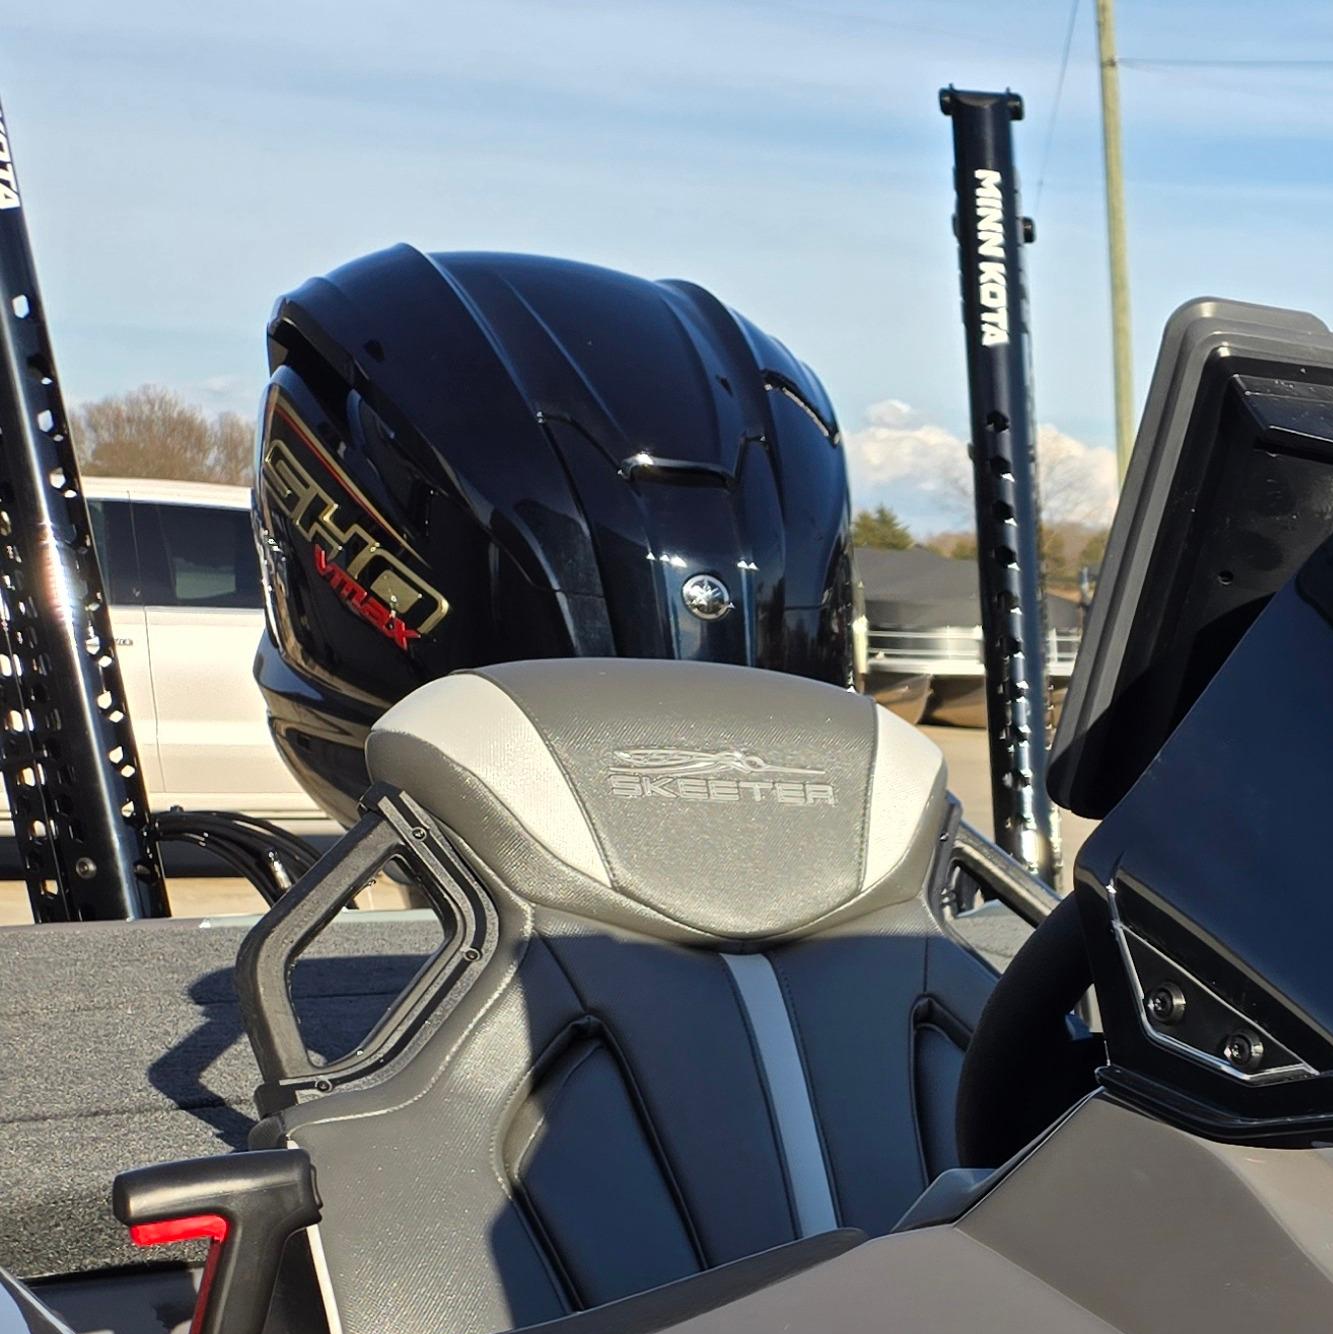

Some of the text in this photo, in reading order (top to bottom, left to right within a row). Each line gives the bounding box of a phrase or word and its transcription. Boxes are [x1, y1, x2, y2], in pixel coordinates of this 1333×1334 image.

[974, 168, 1010, 347] MINN KOTA
[263, 439, 449, 635] SHO
[608, 774, 836, 806] SKEETER
